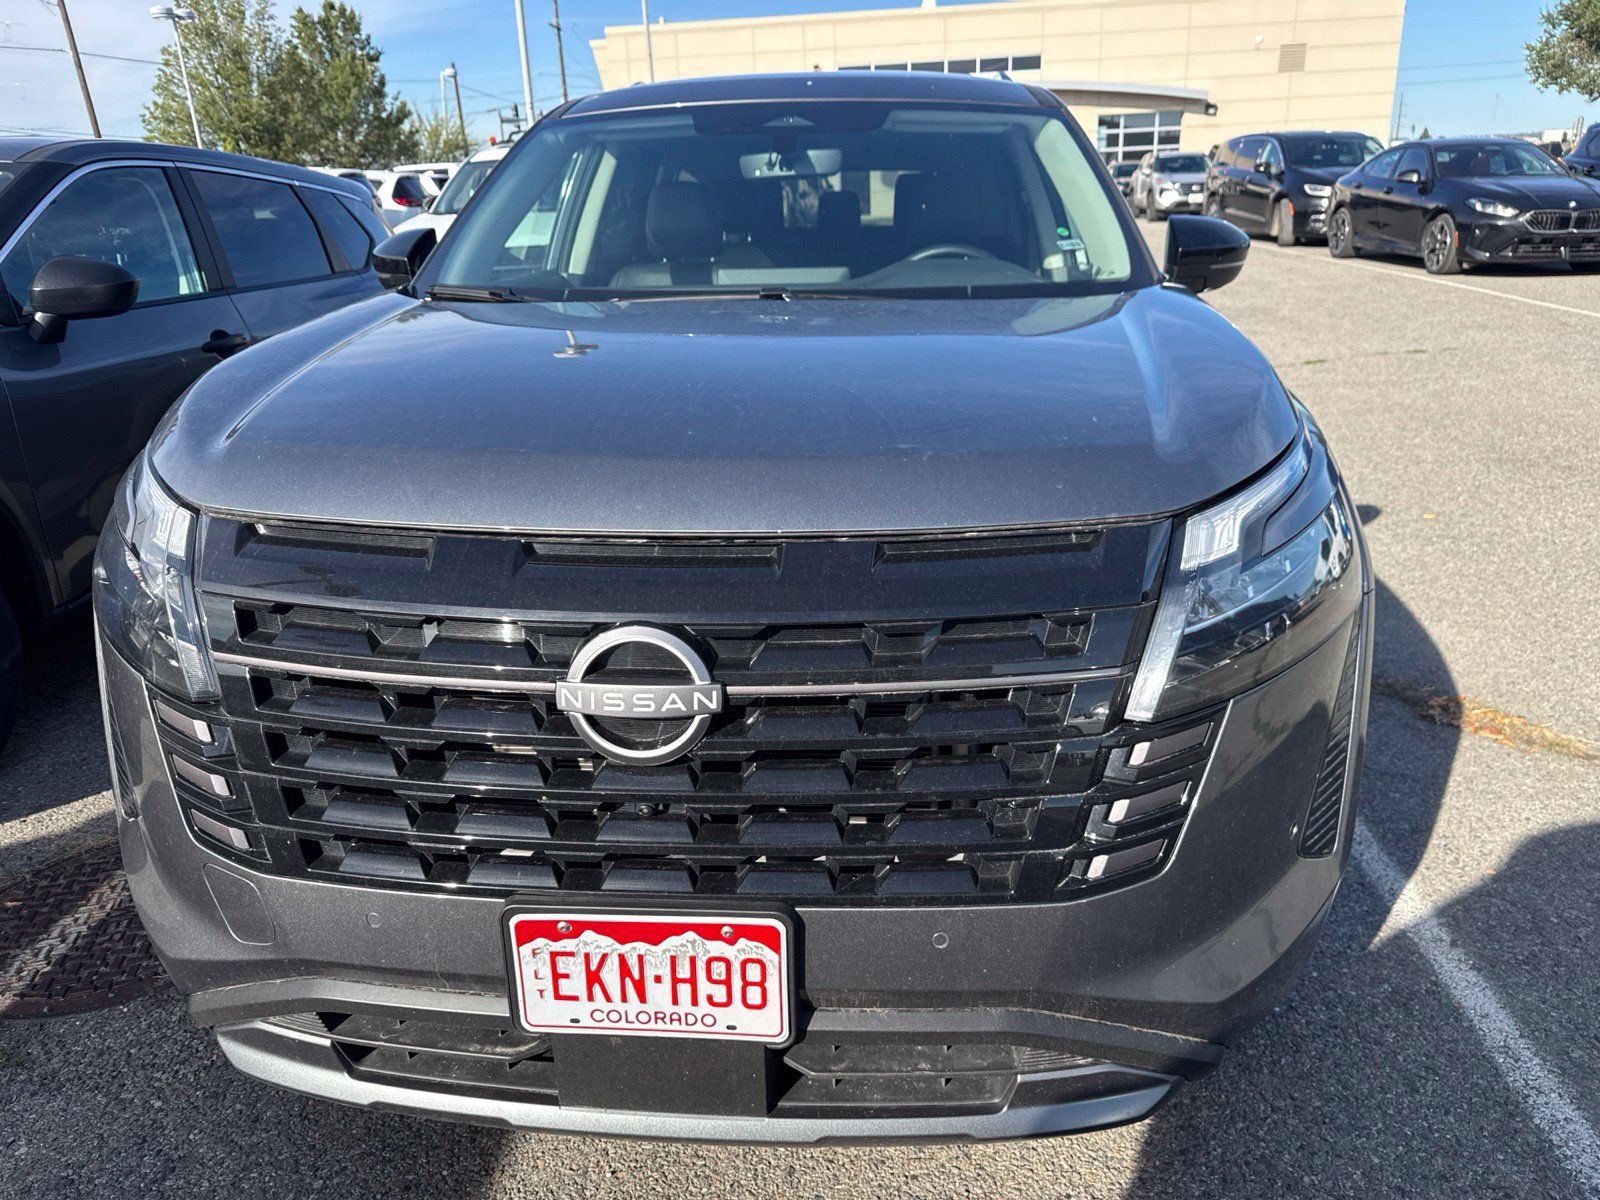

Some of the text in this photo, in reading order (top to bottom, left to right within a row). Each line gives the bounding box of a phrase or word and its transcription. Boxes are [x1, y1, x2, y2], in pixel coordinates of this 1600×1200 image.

[561, 688, 717, 711] NISSAN
[531, 948, 545, 999] FLT
[590, 1009, 717, 1028] COLORADO
